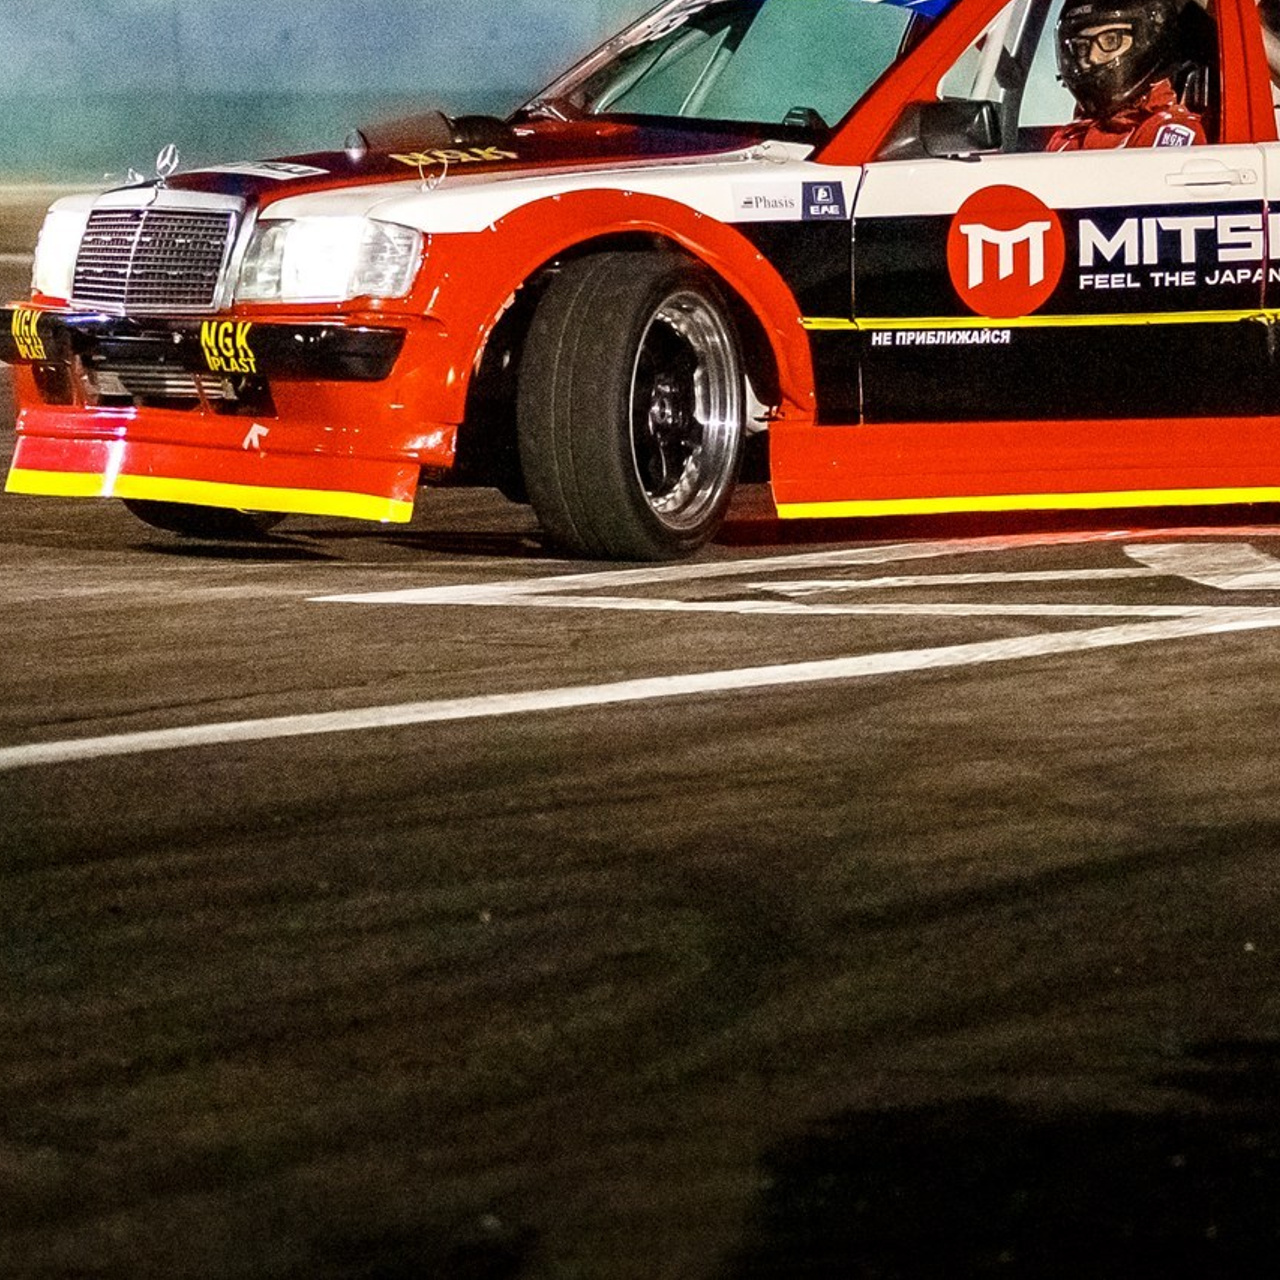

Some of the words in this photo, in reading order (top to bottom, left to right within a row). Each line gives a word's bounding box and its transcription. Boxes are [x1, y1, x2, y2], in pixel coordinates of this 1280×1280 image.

[754, 195, 796, 209] Phasis
[1079, 273, 1141, 290] FEEL
[1150, 270, 1197, 287] THE
[201, 321, 254, 360] NGK
[871, 332, 893, 346] НЕ
[895, 328, 1011, 346] ПРИБЛИЖАЙСЯ
[209, 356, 256, 373] PLAST
